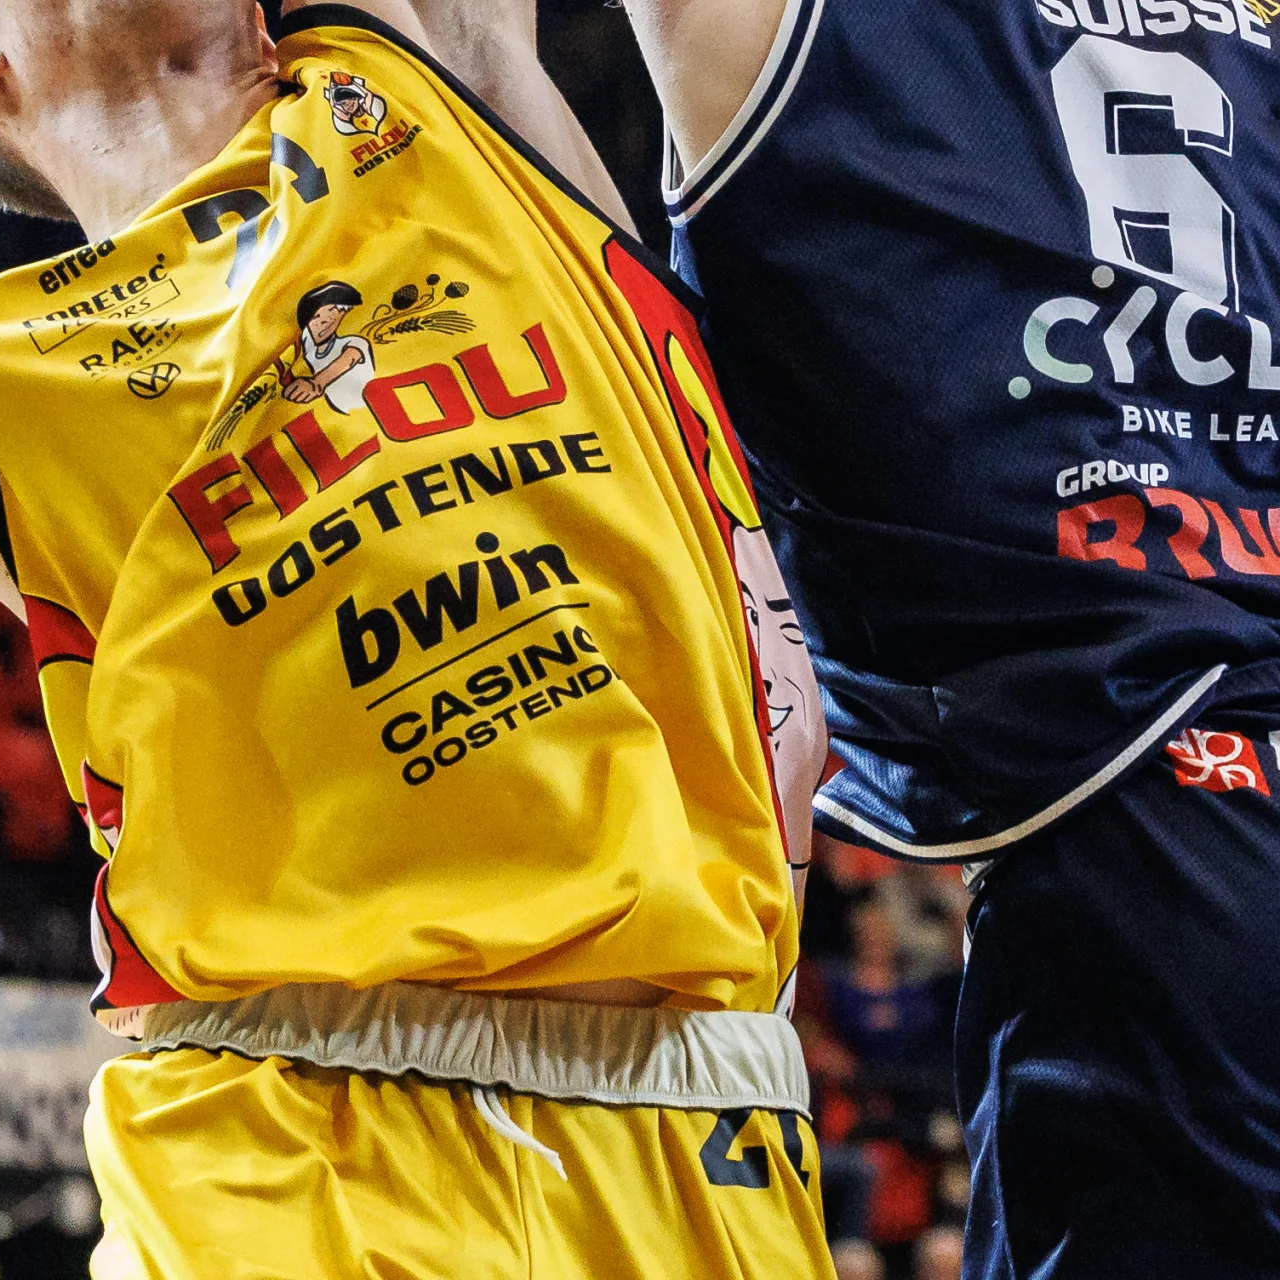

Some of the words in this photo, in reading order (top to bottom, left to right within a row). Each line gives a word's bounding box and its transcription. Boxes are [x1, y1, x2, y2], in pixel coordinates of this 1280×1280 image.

[349, 119, 410, 164] FILOU
[352, 124, 424, 179] OOSTENDE
[1051, 34, 1240, 314] 6
[167, 322, 568, 575] FILOU
[1056, 459, 1170, 499] GROUP
[1122, 404, 1193, 440] BIKE
[212, 431, 612, 627] OOSTENDE
[335, 531, 580, 689] bwin
[402, 664, 617, 786] OOSTEND
